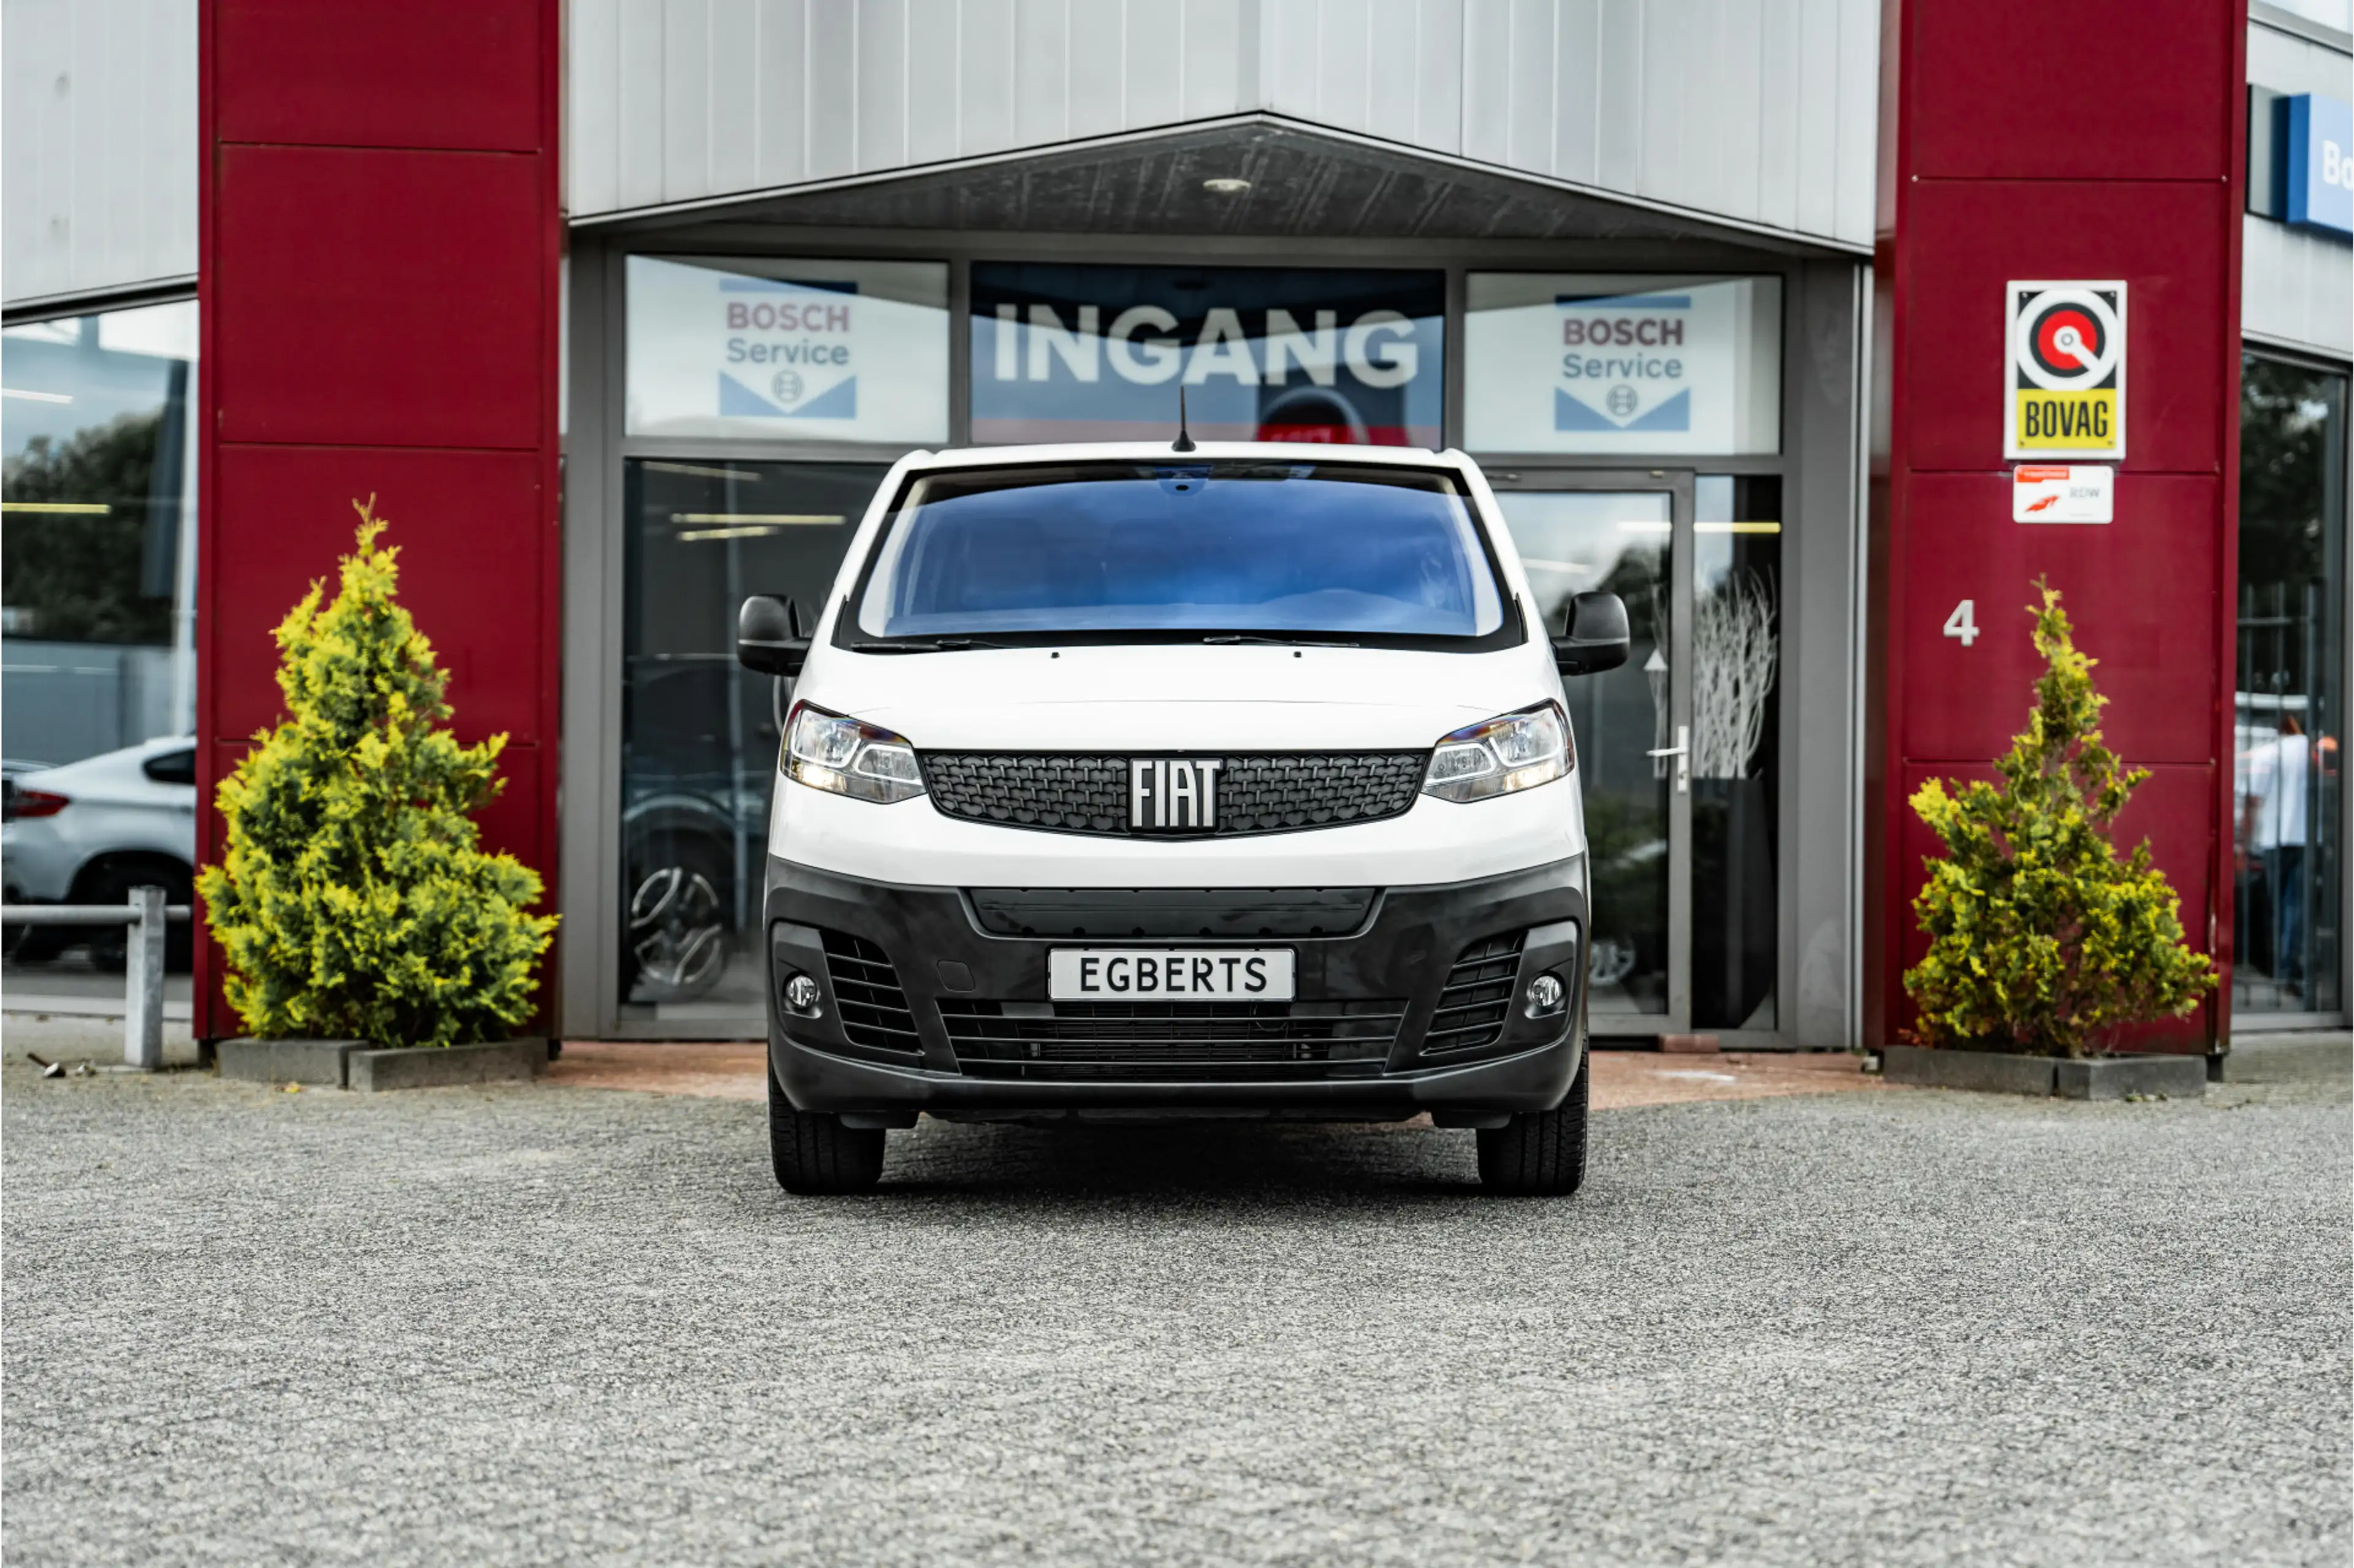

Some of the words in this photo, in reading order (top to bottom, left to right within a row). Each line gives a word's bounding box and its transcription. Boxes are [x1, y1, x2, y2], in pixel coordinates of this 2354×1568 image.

[727, 302, 850, 332] BOSCH
[1564, 318, 1683, 346] BOSCH
[726, 338, 850, 365] Service
[996, 304, 1419, 389] INGANG
[1563, 351, 1683, 379] Service
[2026, 400, 2108, 437] BOVAG
[1943, 599, 1979, 646] 4
[1132, 760, 1221, 827] FIAT
[1080, 957, 1267, 992] EGBERTS
